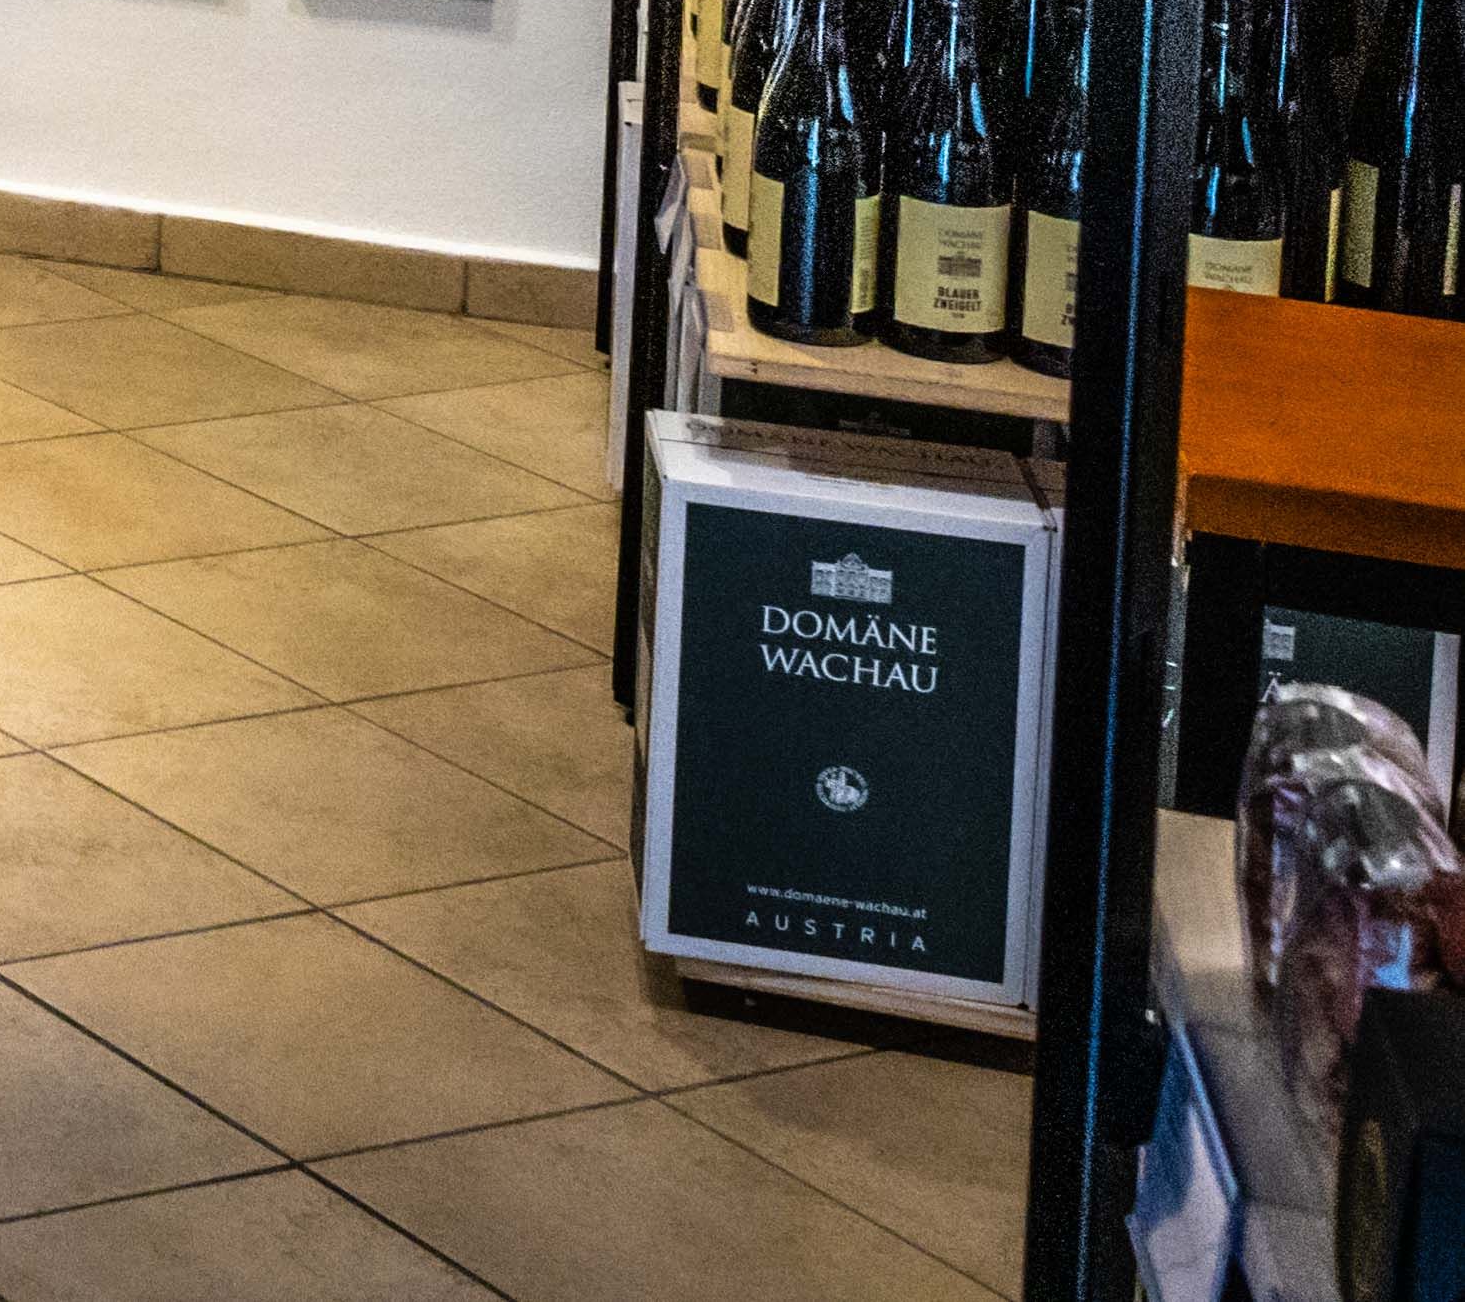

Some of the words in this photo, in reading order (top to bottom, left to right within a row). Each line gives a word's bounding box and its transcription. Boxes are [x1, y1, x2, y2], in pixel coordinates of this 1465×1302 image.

[933, 297, 982, 313] ZWEIGELT
[937, 285, 980, 300] BLAUER
[759, 603, 938, 656] DOMÄNE
[759, 642, 939, 694] WACHAU
[746, 882, 928, 922] www.domaene-wachau.at
[745, 909, 927, 953] AUSTRIA
